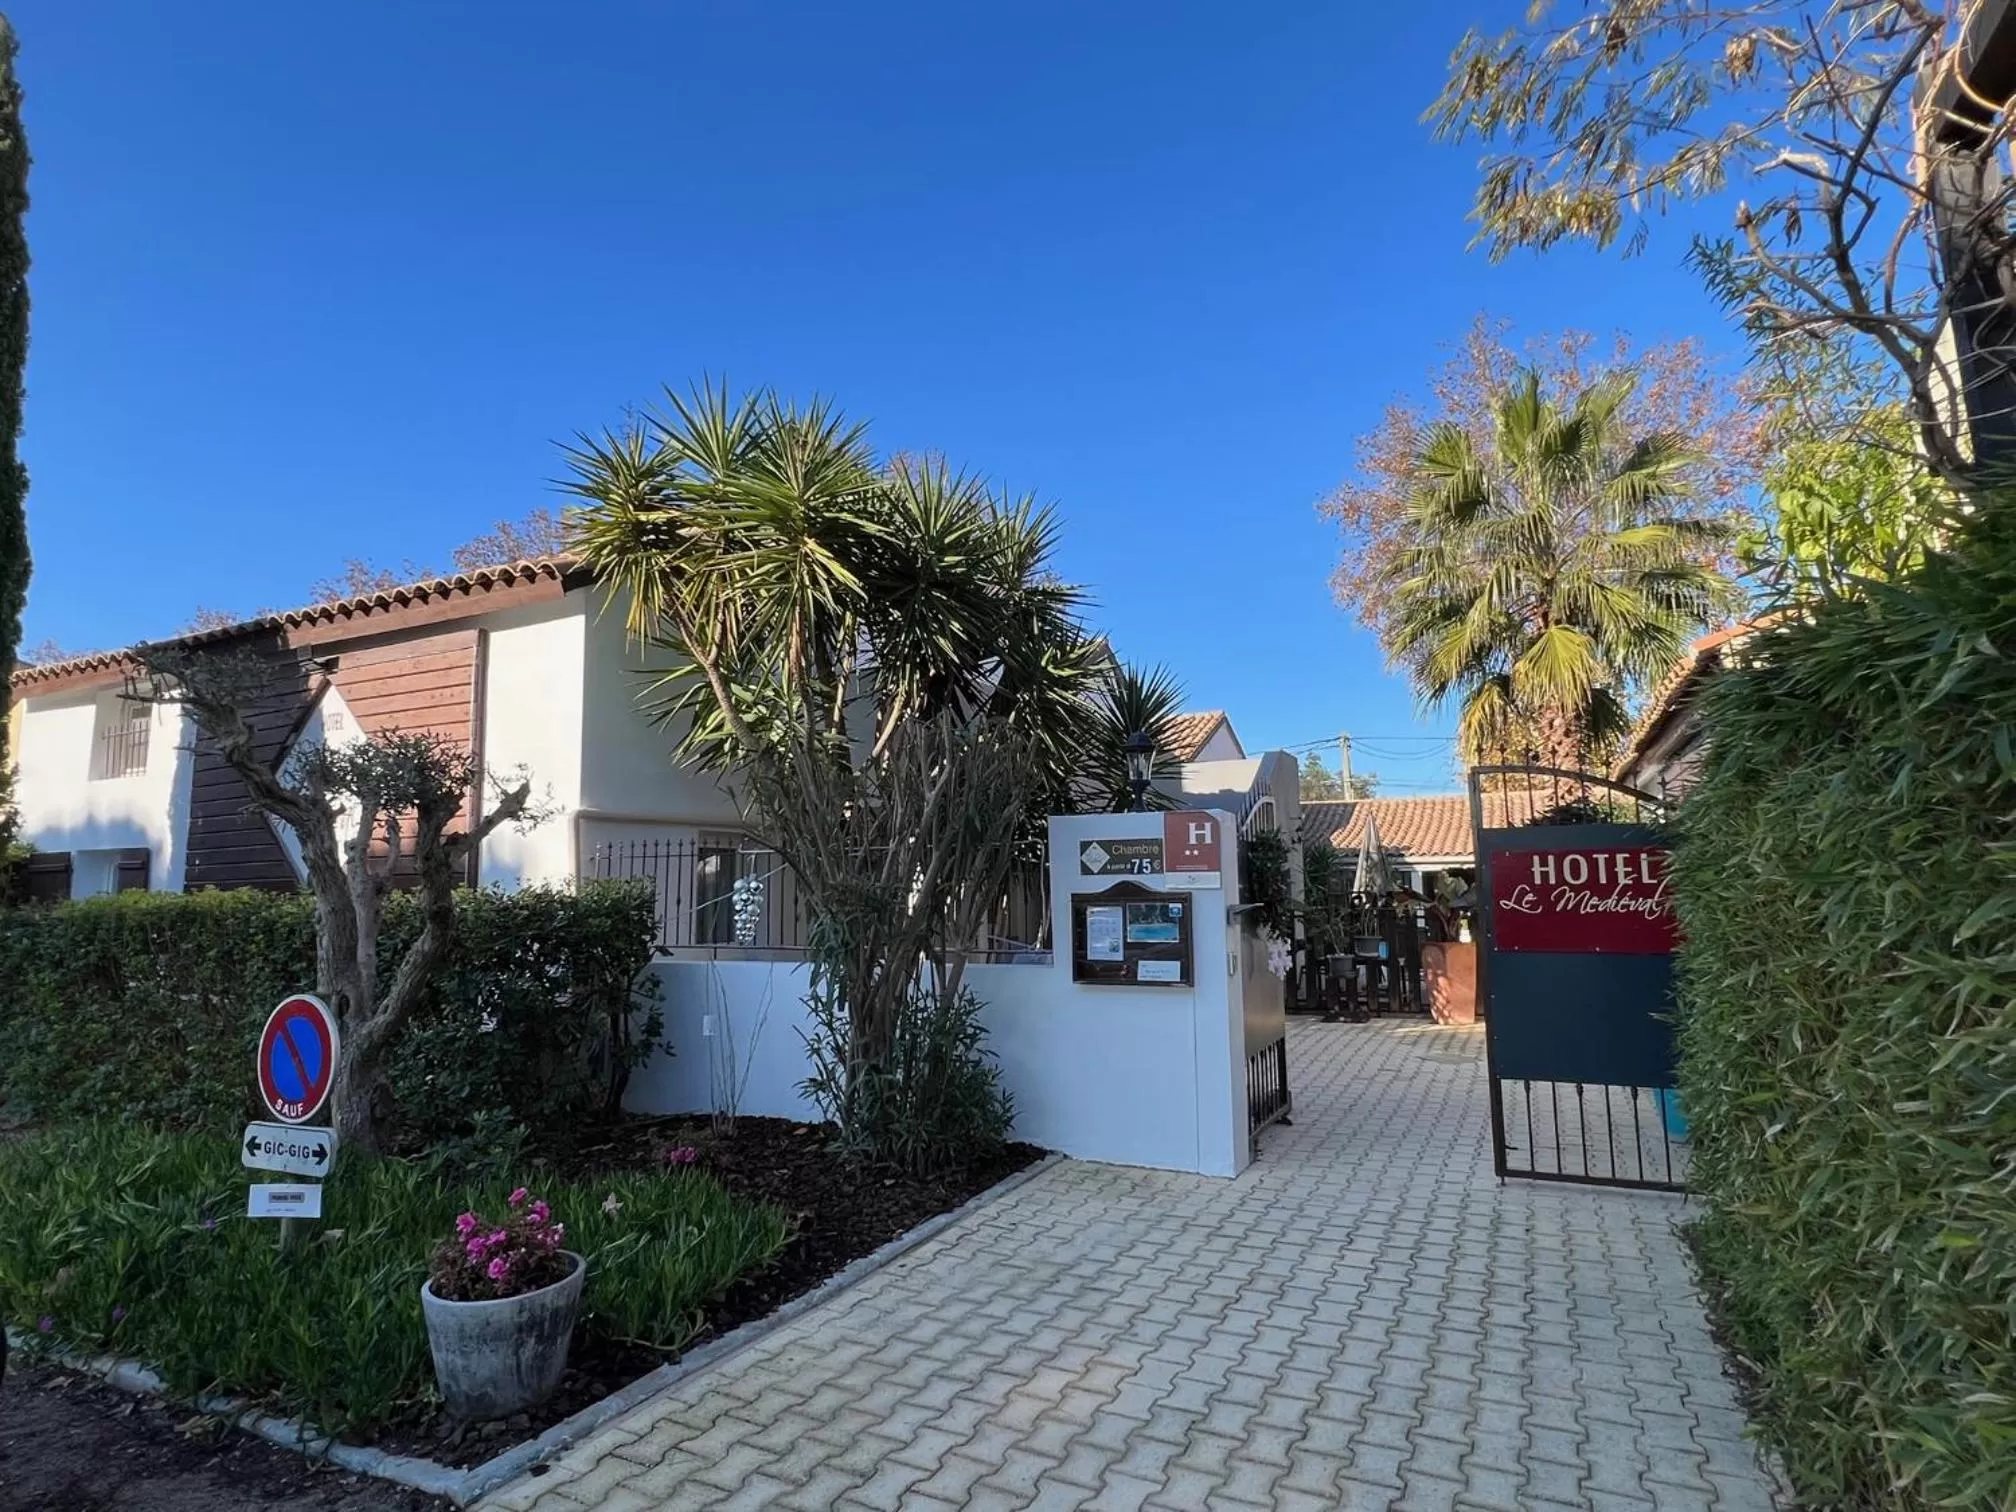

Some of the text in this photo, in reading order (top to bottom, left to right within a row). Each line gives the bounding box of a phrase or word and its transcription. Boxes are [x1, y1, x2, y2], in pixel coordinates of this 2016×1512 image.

[1186, 822, 1213, 845] H
[1111, 844, 1160, 855] Chambre
[1531, 853, 1658, 885] HOTEL
[1499, 884, 1542, 914] Le
[275, 1098, 304, 1117] SAUF
[264, 1141, 310, 1159] GIC-GIG
